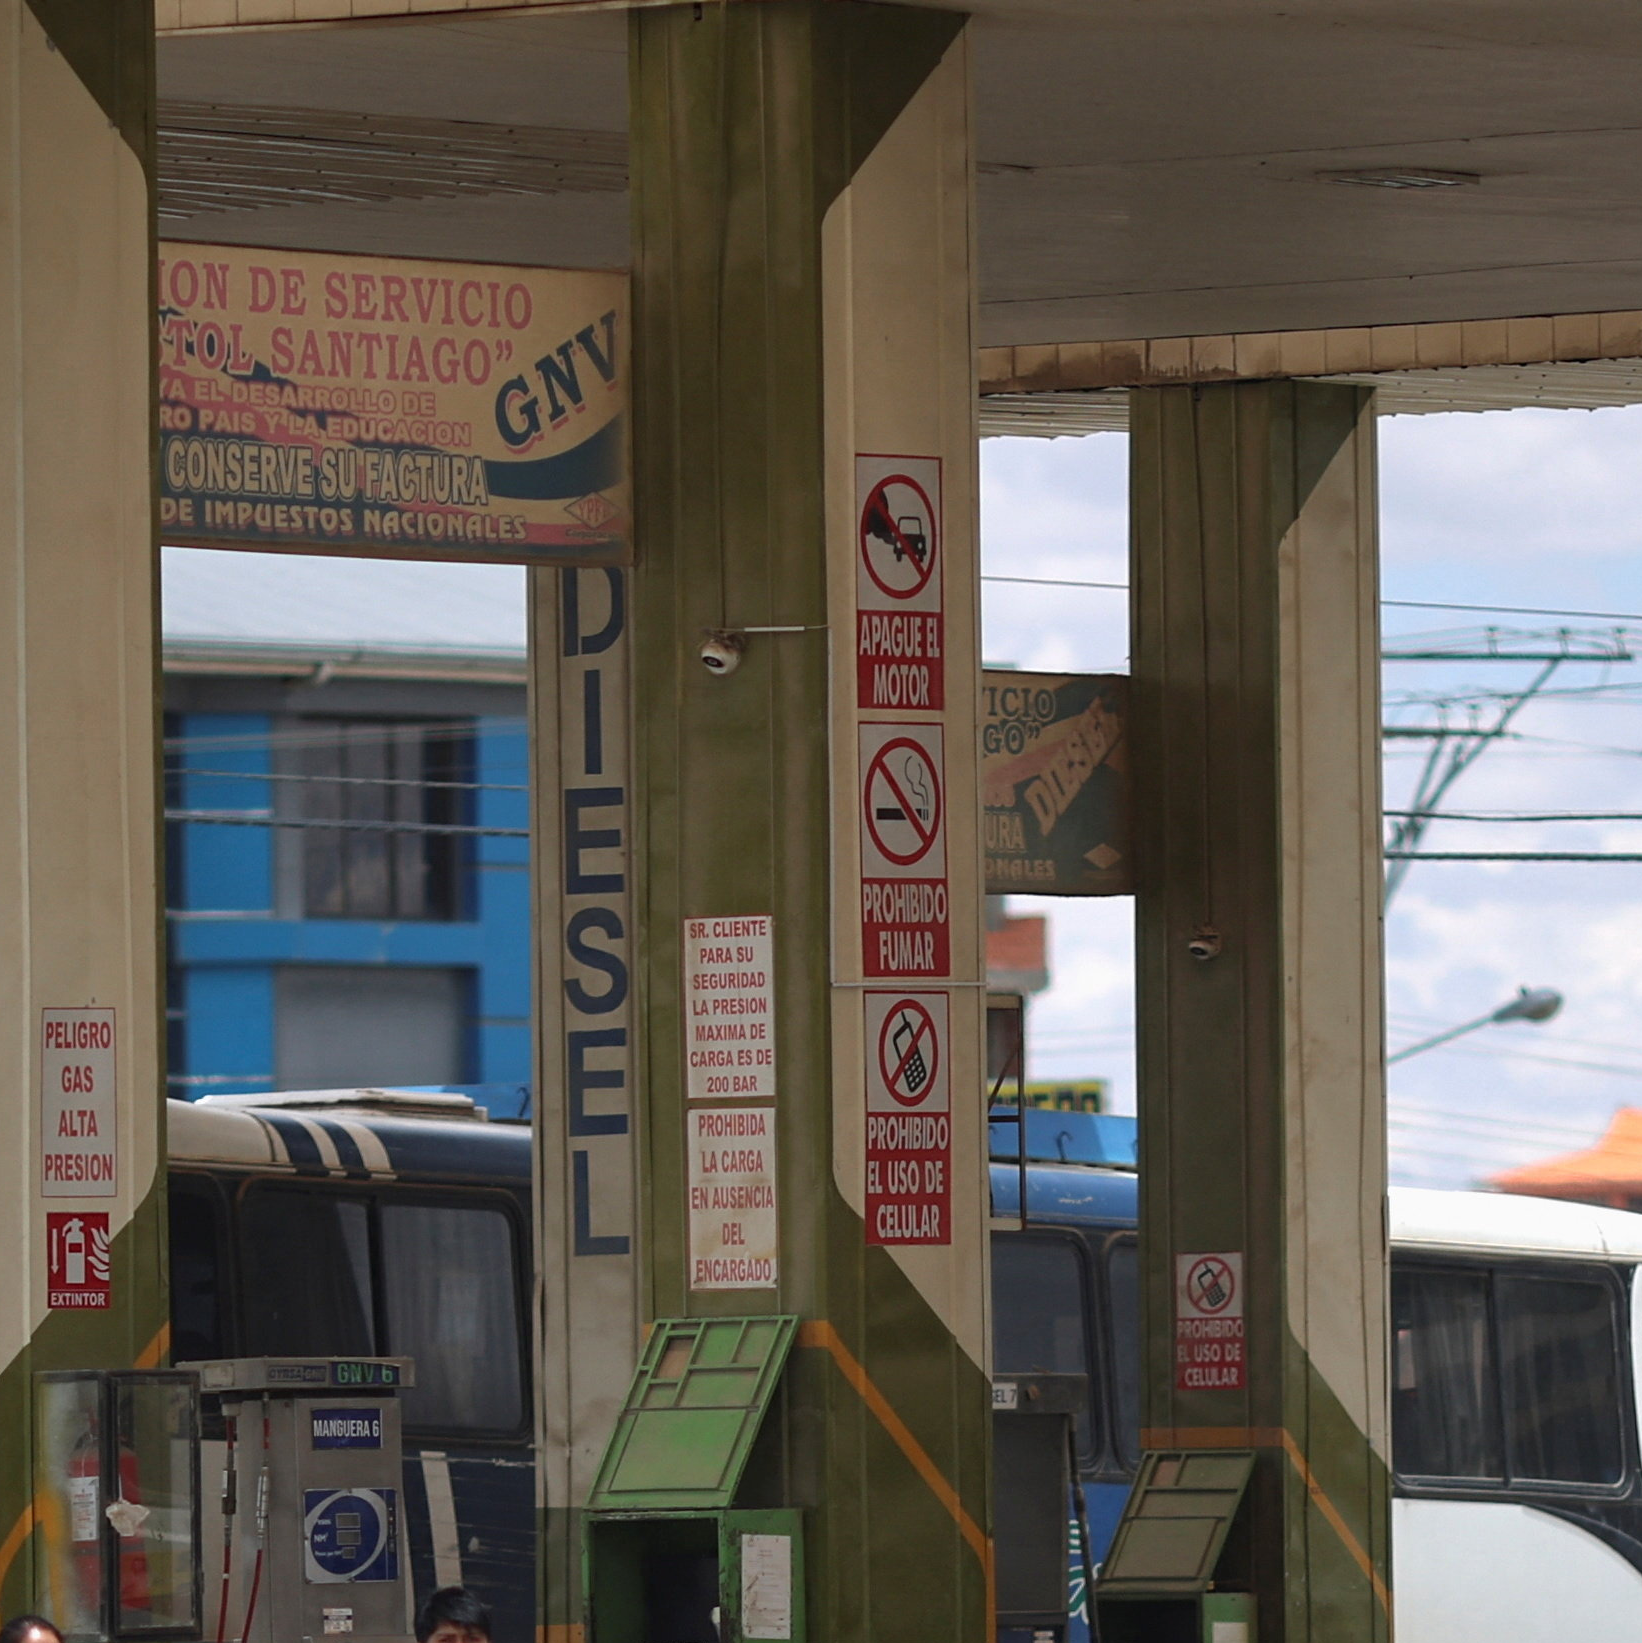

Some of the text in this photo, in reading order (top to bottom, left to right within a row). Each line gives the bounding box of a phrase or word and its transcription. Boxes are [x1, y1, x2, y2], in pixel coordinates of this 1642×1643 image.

[248, 266, 306, 316] DE
[324, 270, 533, 330] SERVICIO
[158, 318, 254, 372] TOL
[494, 309, 619, 450] GNV
[194, 379, 225, 402] EL
[232, 381, 397, 413] DESARROLLO
[401, 390, 436, 417] DE
[199, 408, 257, 433] PAIS
[263, 411, 281, 434] Y
[288, 415, 321, 438] LA
[327, 416, 472, 447] EDUCACION
[167, 436, 489, 506] CONSERVE SU FACTURA
[160, 497, 527, 541] DE IMPUESTOS NACIONALES
[859, 614, 940, 658] APAGUE EL
[873, 664, 929, 706] MOTOR
[983, 686, 1056, 720] ICIO
[563, 565, 630, 1257] DIESEL
[863, 884, 947, 924] PROHIBIDO
[690, 920, 767, 939] SR. CLIENTE
[700, 946, 754, 964] PARA SU
[879, 931, 935, 971] FUMAR
[693, 971, 766, 990] SEGURIDAD
[693, 997, 767, 1016] LA PRESION
[45, 1021, 111, 1049] PELIGRO
[695, 1023, 766, 1042] MAXIMA DE
[690, 1048, 772, 1068] CARGA ES DE
[61, 1065, 94, 1094] GAS
[707, 1075, 757, 1093] 200 BAR
[58, 1109, 98, 1138] ALTA
[698, 1114, 766, 1137] PROHIBIDA
[867, 1117, 949, 1150] PROHIBIDO
[44, 1153, 113, 1182] PRESION
[702, 1150, 764, 1174] LA CARGA
[867, 1160, 944, 1194] EL USO DE
[691, 1185, 774, 1210] EN AUSENCIA
[722, 1222, 745, 1246] DEL
[876, 1205, 940, 1239] CELULAR
[695, 1258, 772, 1282] ENCARGADO
[50, 1292, 106, 1307] EXTINTOR
[1177, 1319, 1245, 1338] PROHIBIDO
[1177, 1344, 1241, 1362] EL USO DE
[337, 1363, 374, 1383] GNV
[381, 1365, 394, 1383] 6
[1184, 1367, 1239, 1387] CELULAR
[313, 1419, 380, 1437] MANGUERA 6
